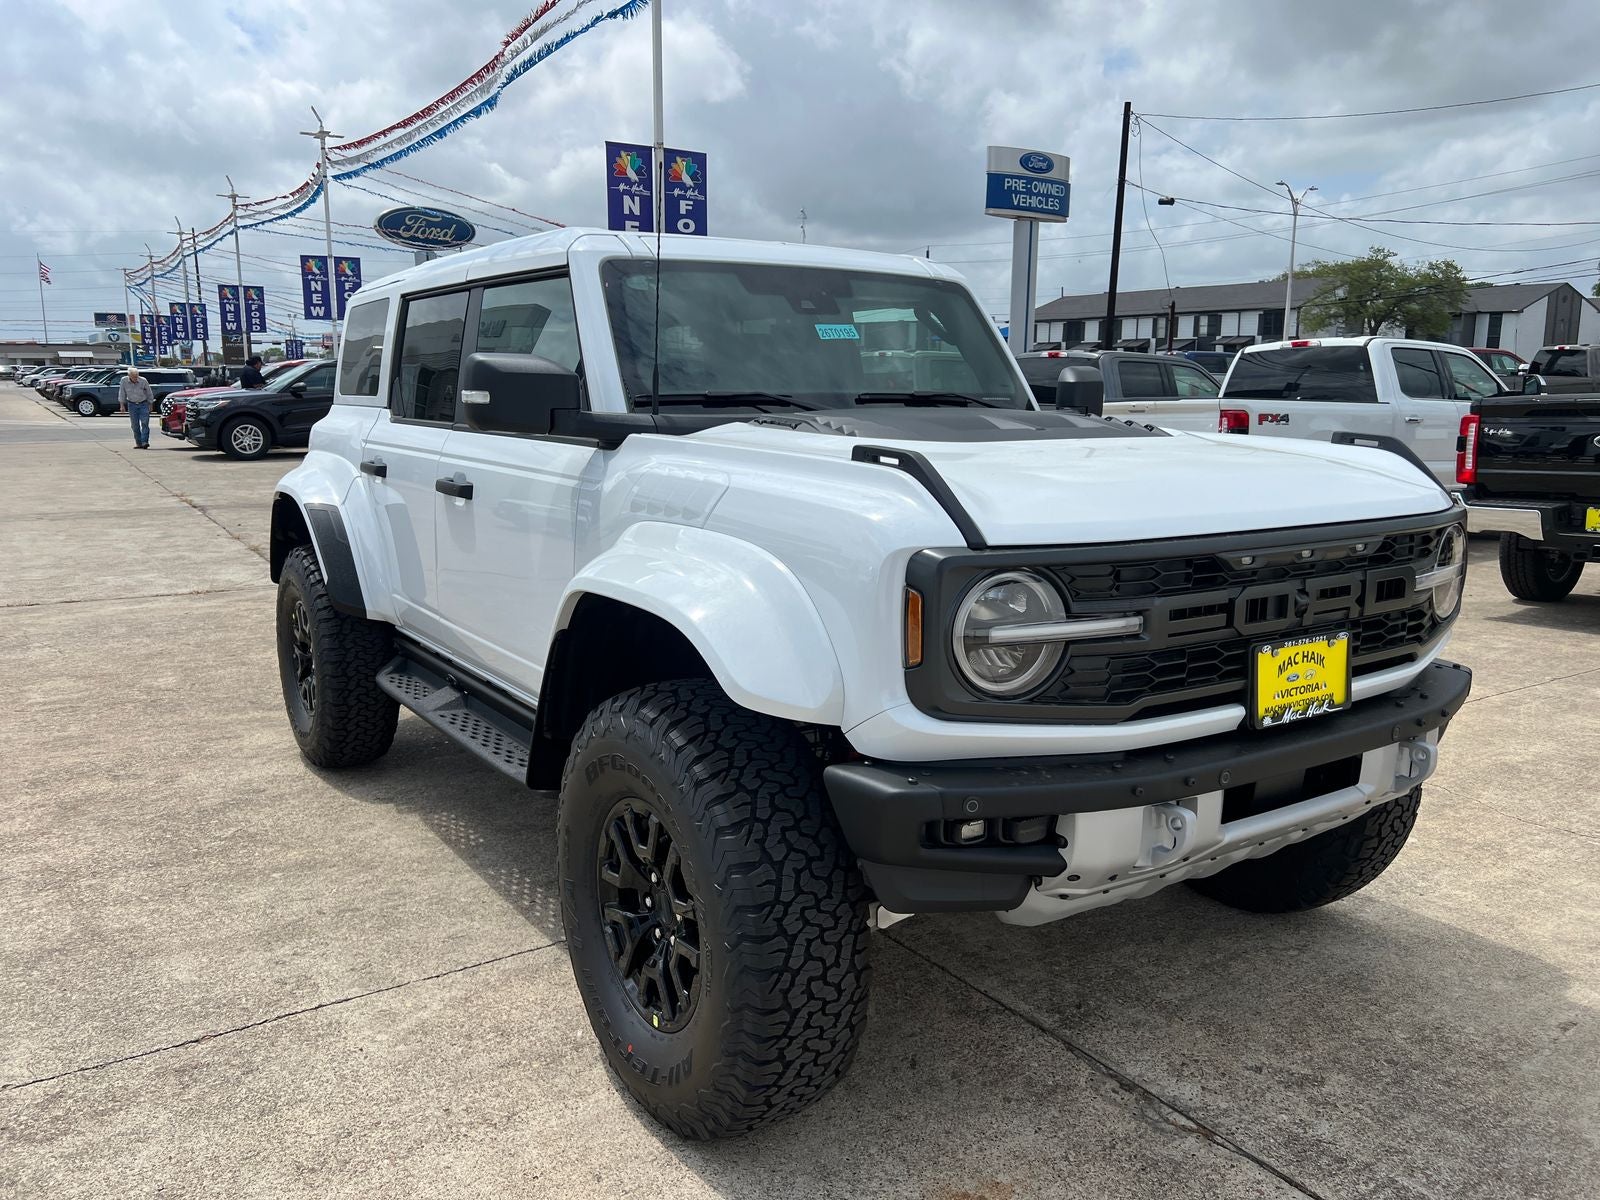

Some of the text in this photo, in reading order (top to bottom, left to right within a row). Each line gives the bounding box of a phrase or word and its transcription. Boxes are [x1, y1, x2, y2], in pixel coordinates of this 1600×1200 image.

[1028, 155, 1048, 169] Ford
[1004, 178, 1066, 197] PRE-OWNED
[1012, 194, 1060, 211] VEHICLES
[400, 214, 456, 242] Ford
[310, 280, 325, 317] NEW
[175, 317, 186, 339] NEW
[225, 303, 237, 331] NEW
[251, 304, 261, 332] FORD
[195, 317, 205, 340] FORD
[819, 328, 856, 339] 26T0195
[1258, 413, 1289, 426] FX4
[1277, 651, 1326, 678] MAC HAIK
[1280, 682, 1320, 699] VICTORIA
